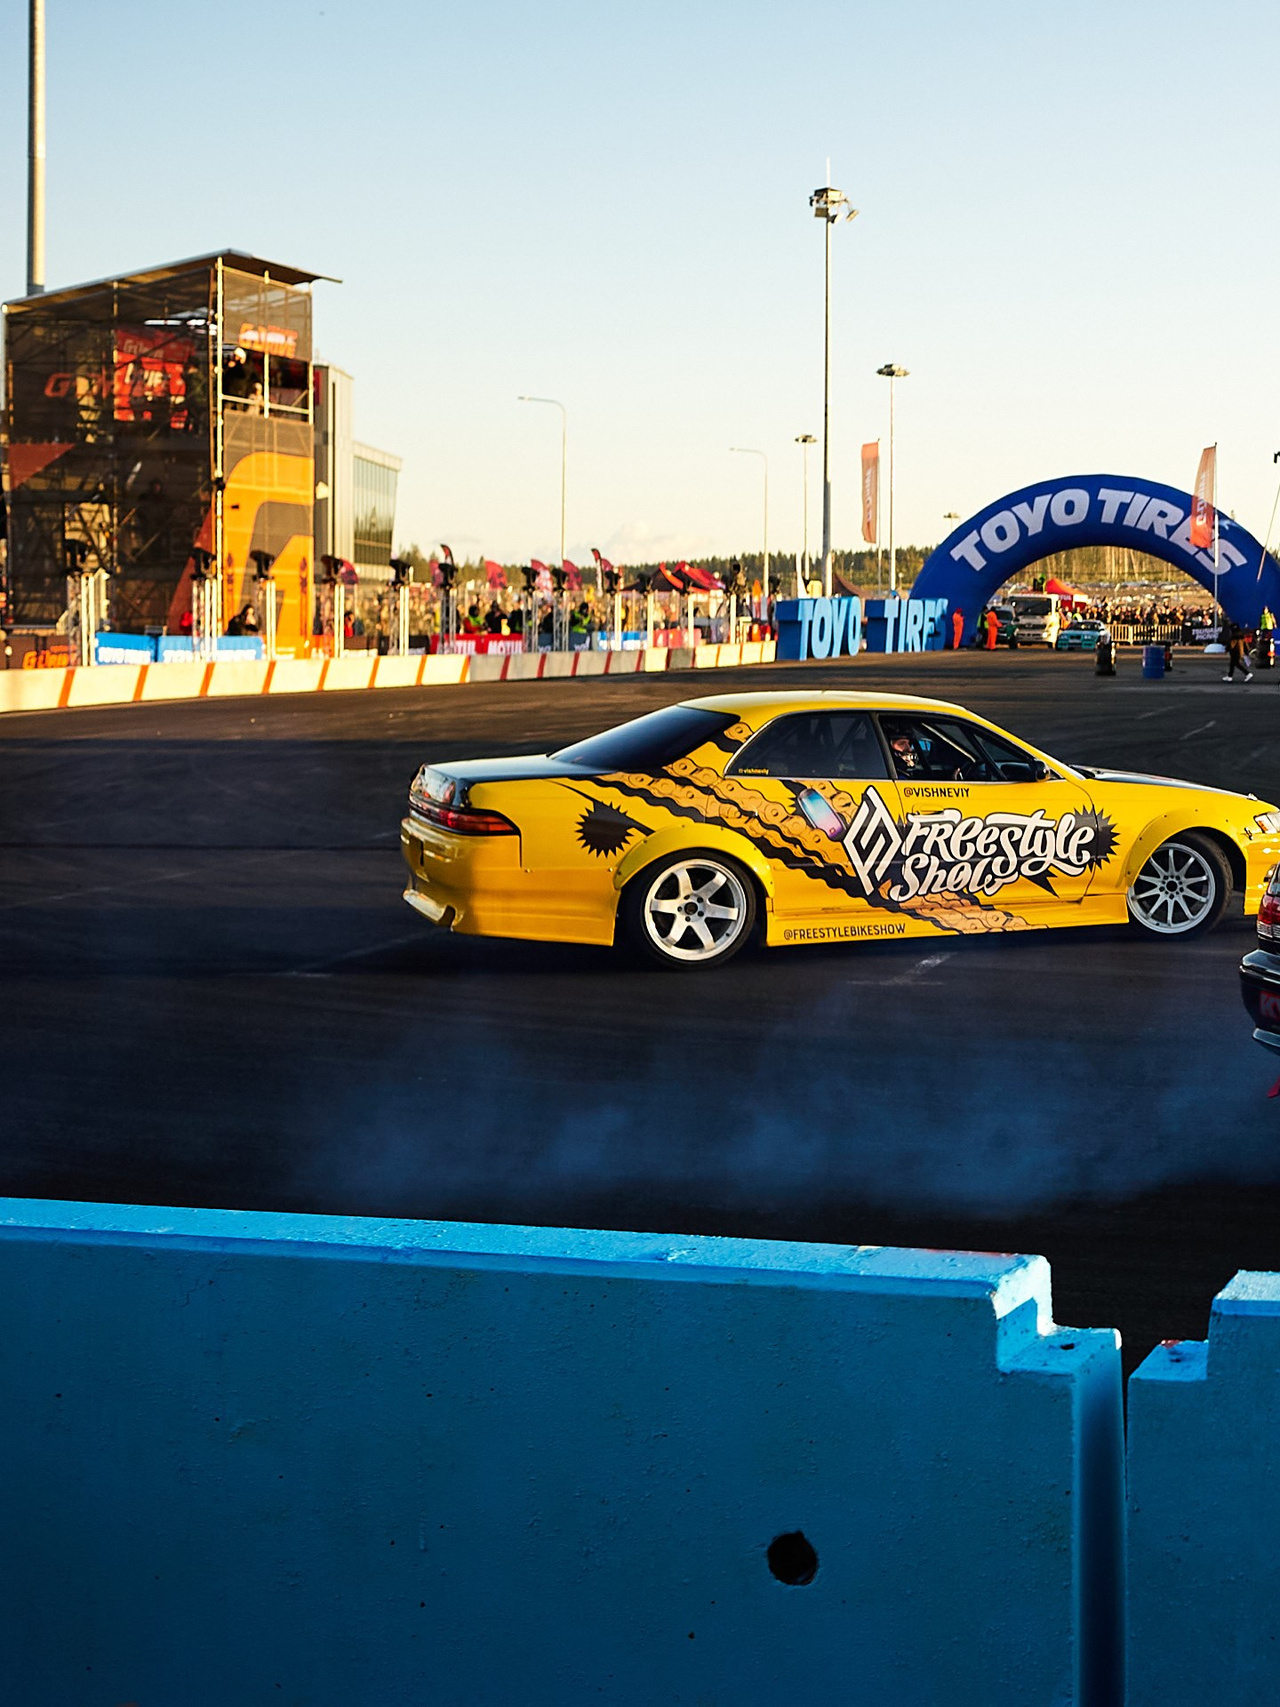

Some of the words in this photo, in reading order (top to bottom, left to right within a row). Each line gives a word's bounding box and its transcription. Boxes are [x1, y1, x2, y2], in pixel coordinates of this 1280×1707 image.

[950, 488, 1090, 572] TOYO
[1097, 488, 1247, 575] TIRES
[798, 596, 861, 661] TOYO
[884, 598, 948, 654] TIRES
[904, 787, 970, 798] @VISHNEVIY
[889, 852, 1019, 902] Show
[783, 923, 906, 941] @FREESTYLEBIKESHOW
